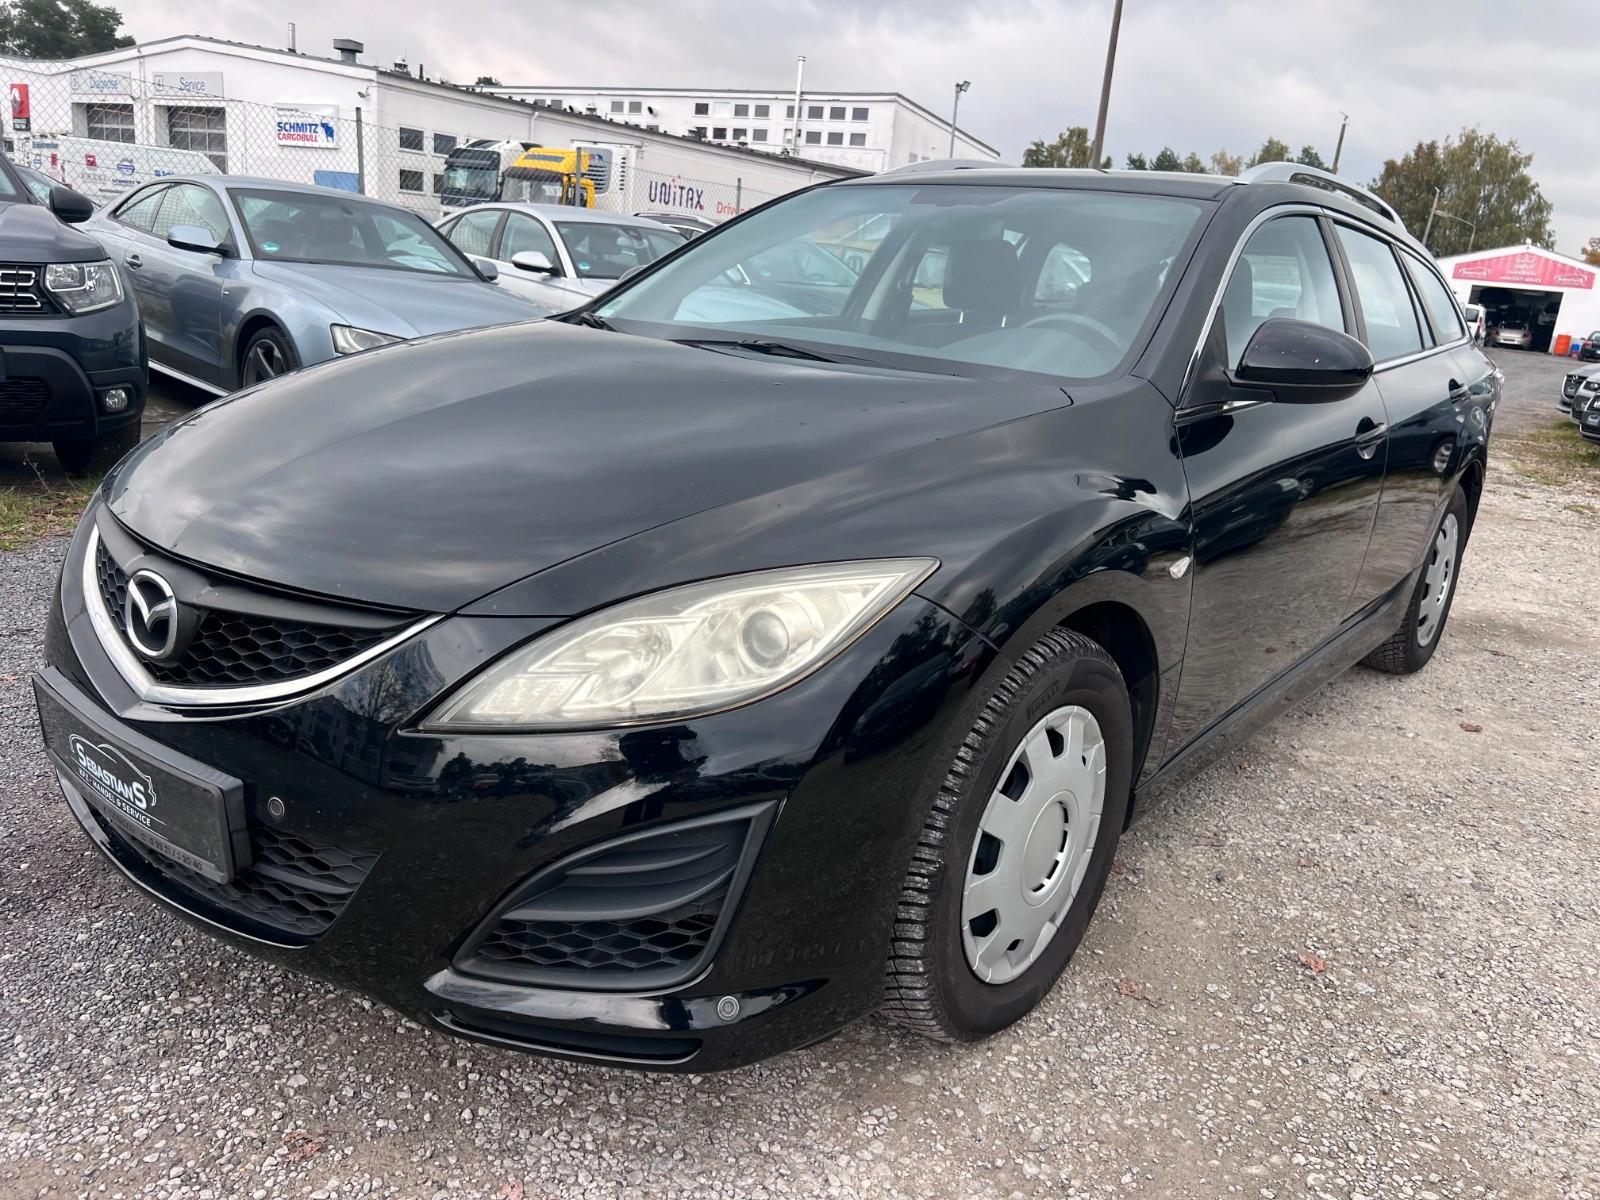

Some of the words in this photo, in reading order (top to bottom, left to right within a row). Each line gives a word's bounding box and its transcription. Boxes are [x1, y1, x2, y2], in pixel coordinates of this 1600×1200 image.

[180, 76, 206, 92] Service
[277, 121, 319, 134] SCHMITZ
[277, 132, 318, 143] CARGOBULL
[122, 802, 151, 827] SERVICE
